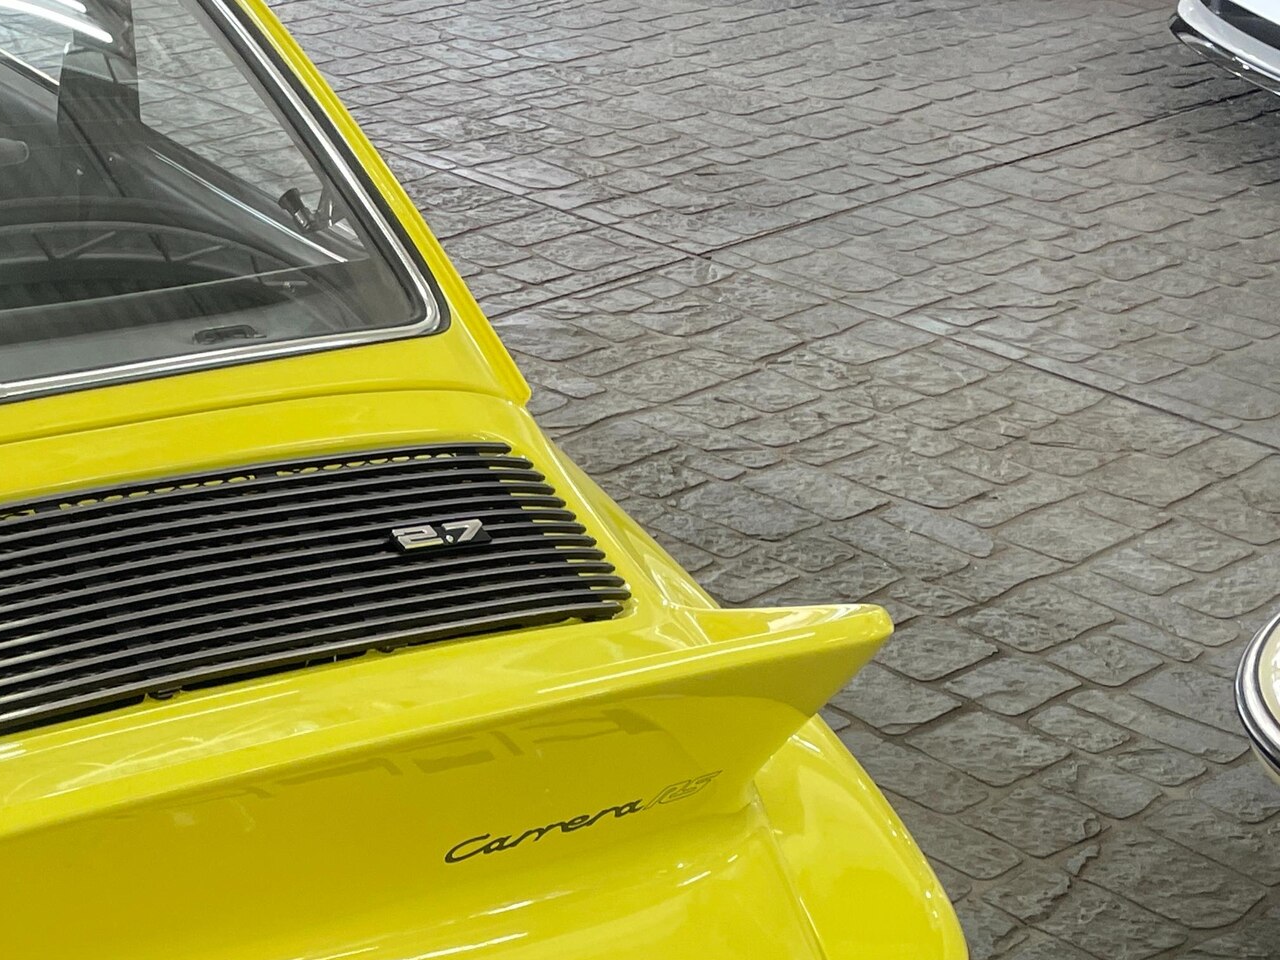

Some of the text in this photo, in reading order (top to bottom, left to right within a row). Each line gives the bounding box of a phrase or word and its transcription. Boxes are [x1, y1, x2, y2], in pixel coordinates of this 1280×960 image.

[391, 519, 483, 550] 2.7
[444, 769, 723, 864] Carrera RS
